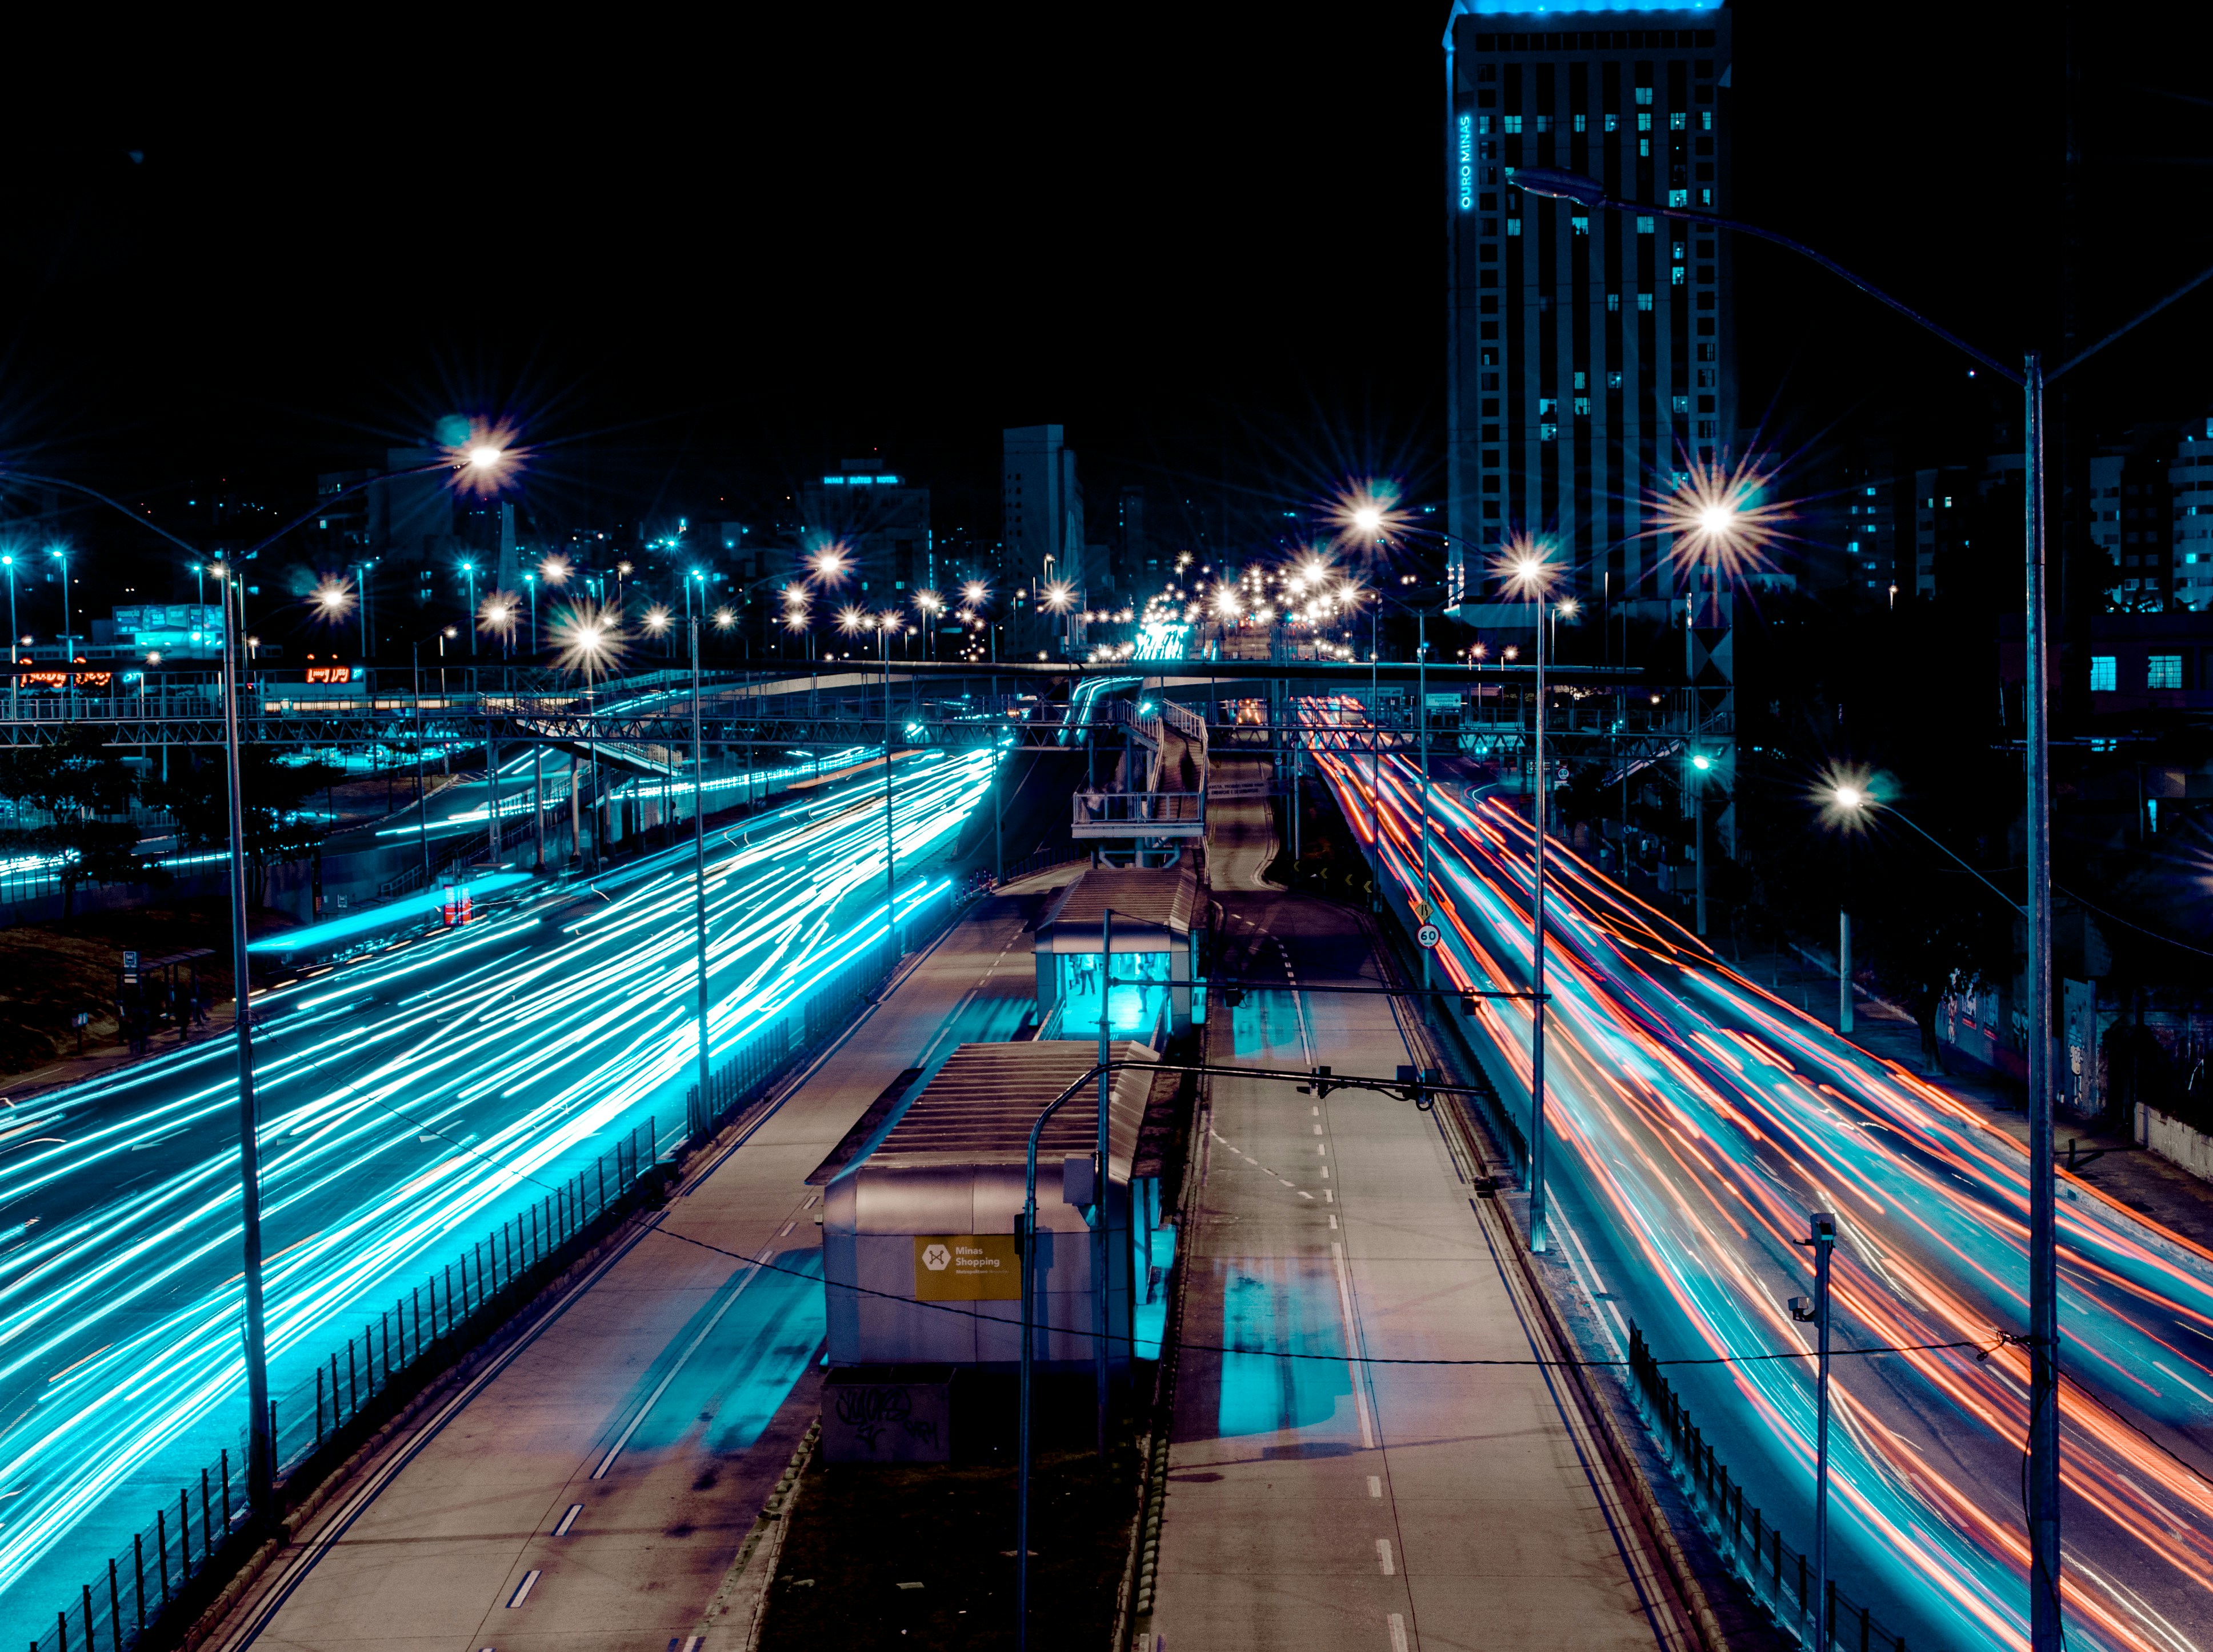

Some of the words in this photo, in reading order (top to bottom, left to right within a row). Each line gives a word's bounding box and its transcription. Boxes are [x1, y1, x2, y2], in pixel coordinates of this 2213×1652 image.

[1460, 116, 1471, 163] MINAS
[1460, 166, 1472, 208] OURO
[1420, 931, 1436, 941] 60
[955, 1247, 983, 1255] Minas
[955, 1257, 1001, 1267] Shopping
